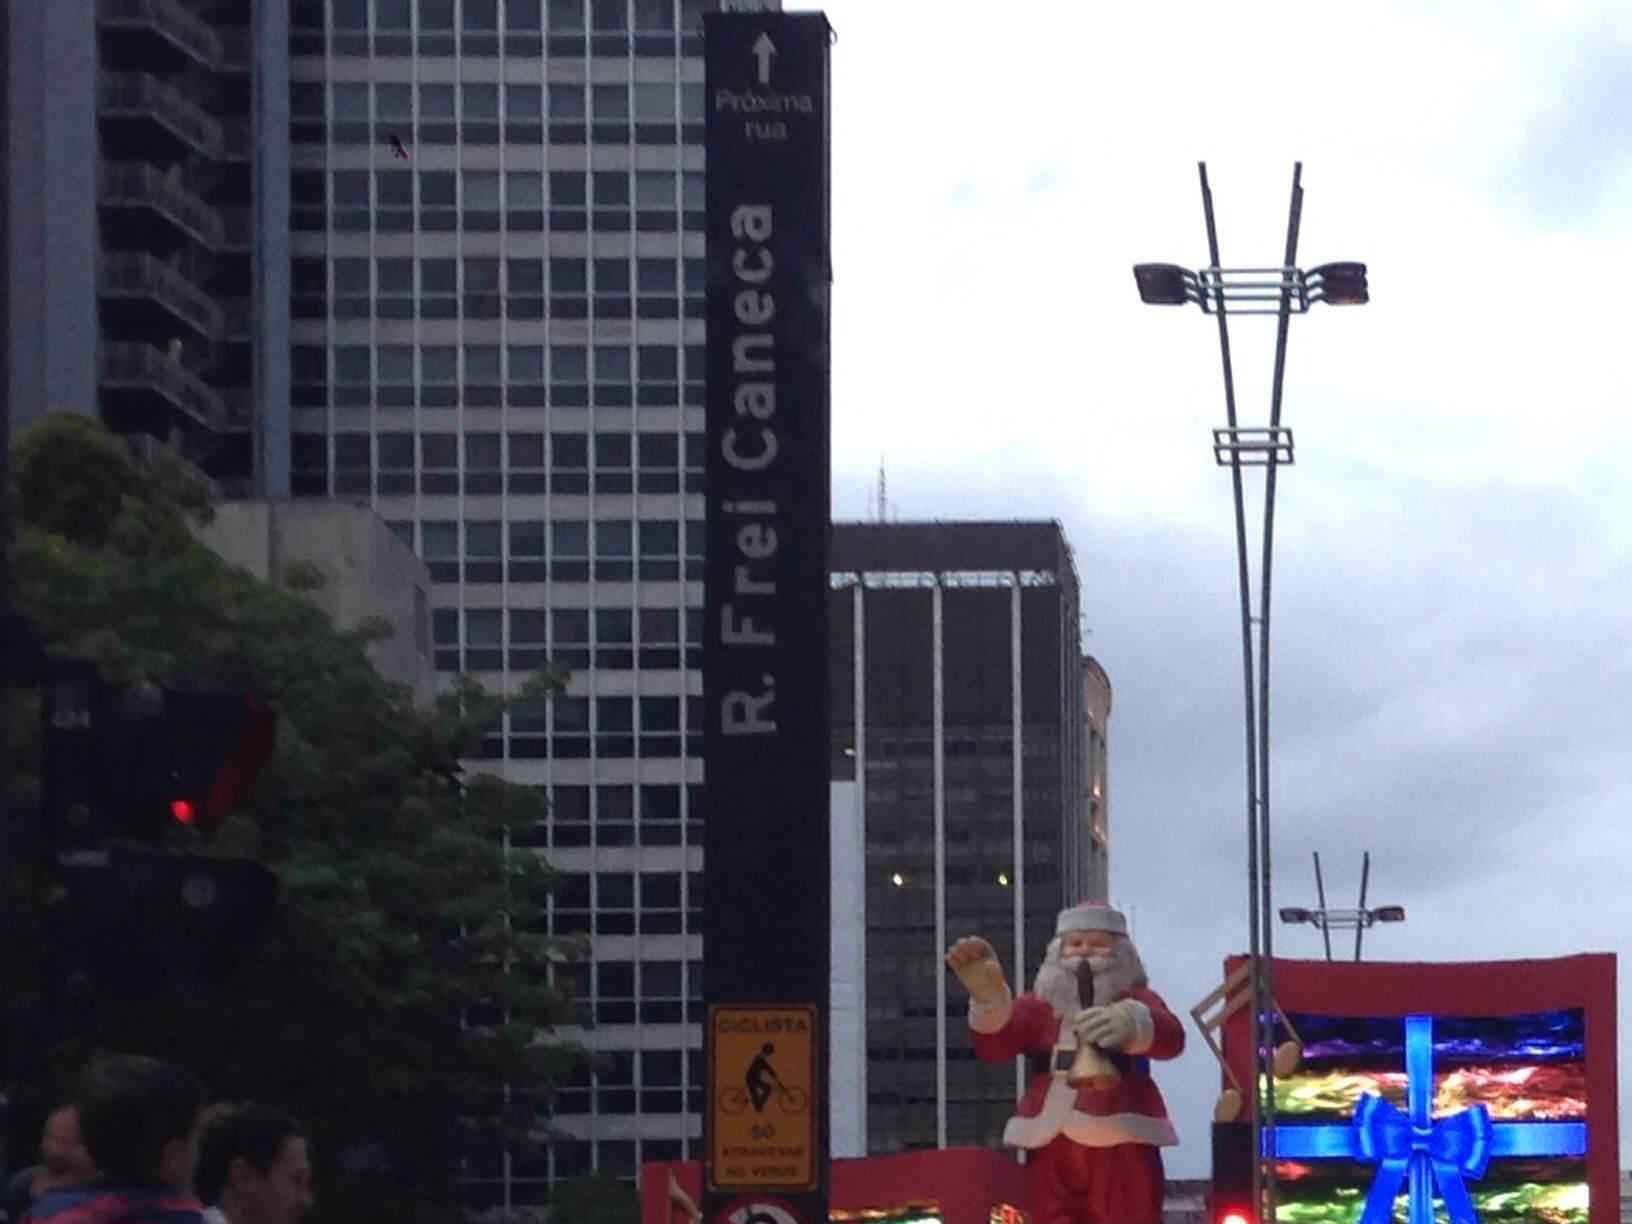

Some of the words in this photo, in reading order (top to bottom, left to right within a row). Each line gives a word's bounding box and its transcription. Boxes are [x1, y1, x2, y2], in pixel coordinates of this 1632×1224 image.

[715, 88, 813, 113] Próxima
[745, 120, 787, 140] rua
[722, 203, 778, 470] Caneca
[721, 501, 777, 645] Frei
[722, 673, 777, 735] R.
[718, 1016, 808, 1034] CICLISTA
